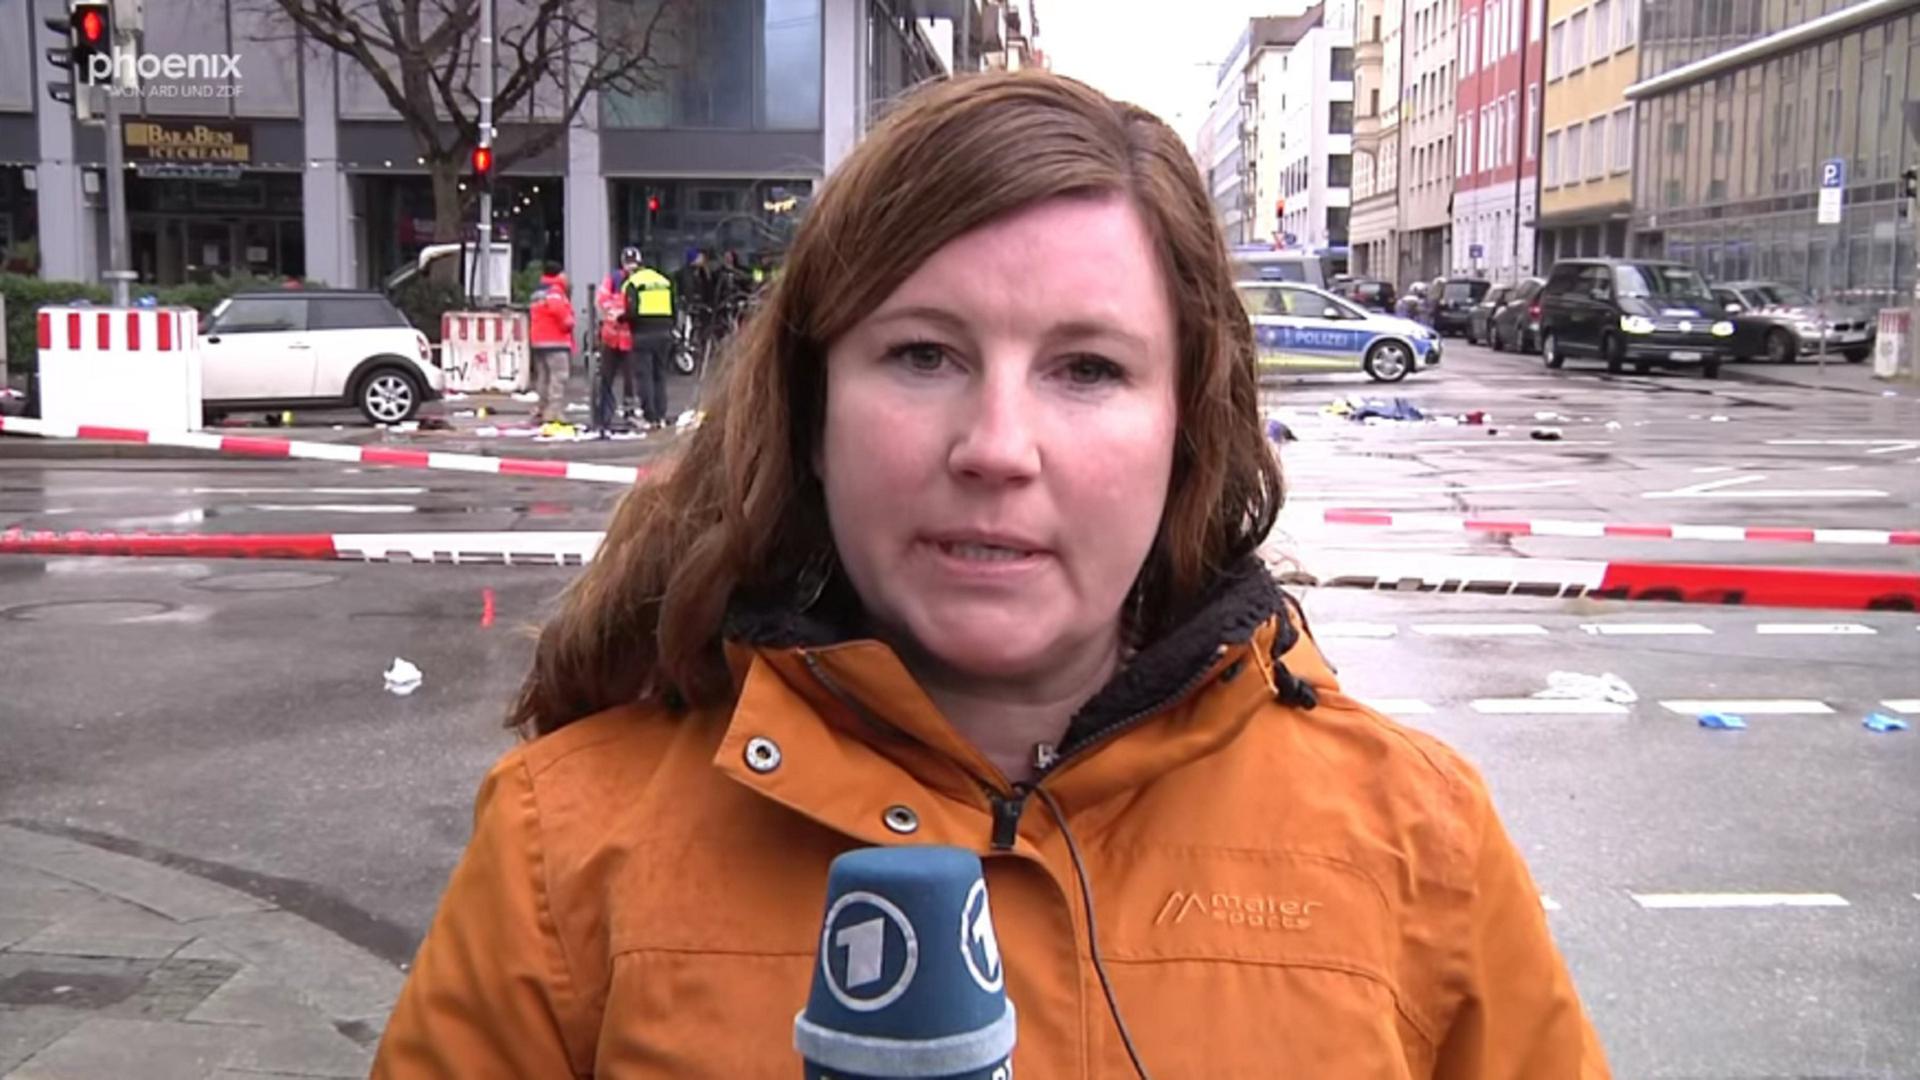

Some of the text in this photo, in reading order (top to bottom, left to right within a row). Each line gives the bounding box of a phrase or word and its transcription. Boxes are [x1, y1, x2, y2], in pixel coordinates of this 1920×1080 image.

[1824, 164, 1837, 186] P
[1295, 330, 1348, 346] POLIZEI
[836, 917, 885, 989] 1
